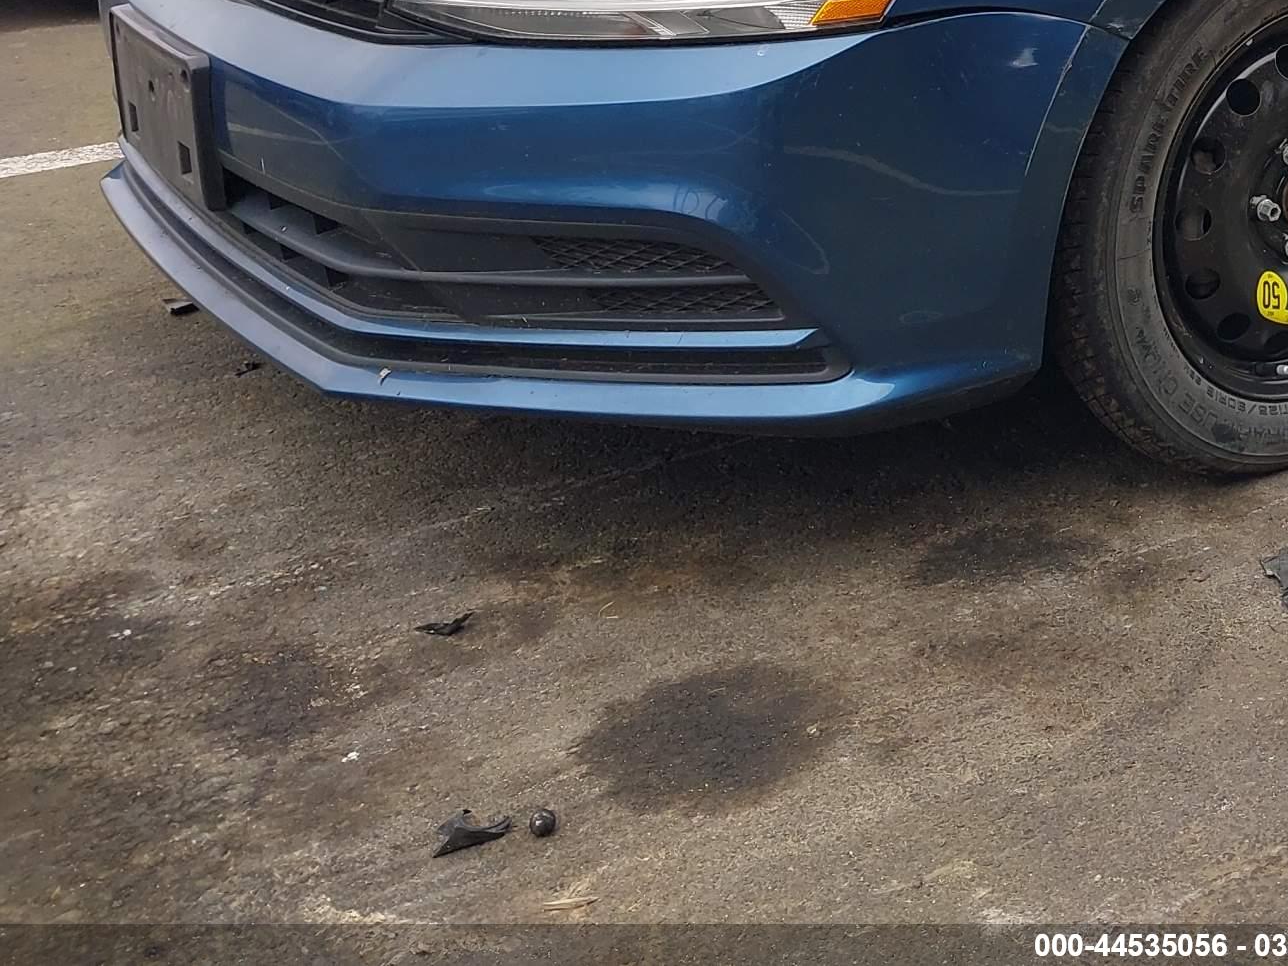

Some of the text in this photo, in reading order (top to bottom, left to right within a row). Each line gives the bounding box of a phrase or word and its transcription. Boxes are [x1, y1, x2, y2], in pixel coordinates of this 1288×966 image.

[1128, 43, 1209, 213] SPARE TIRE
[1262, 280, 1281, 310] 50
